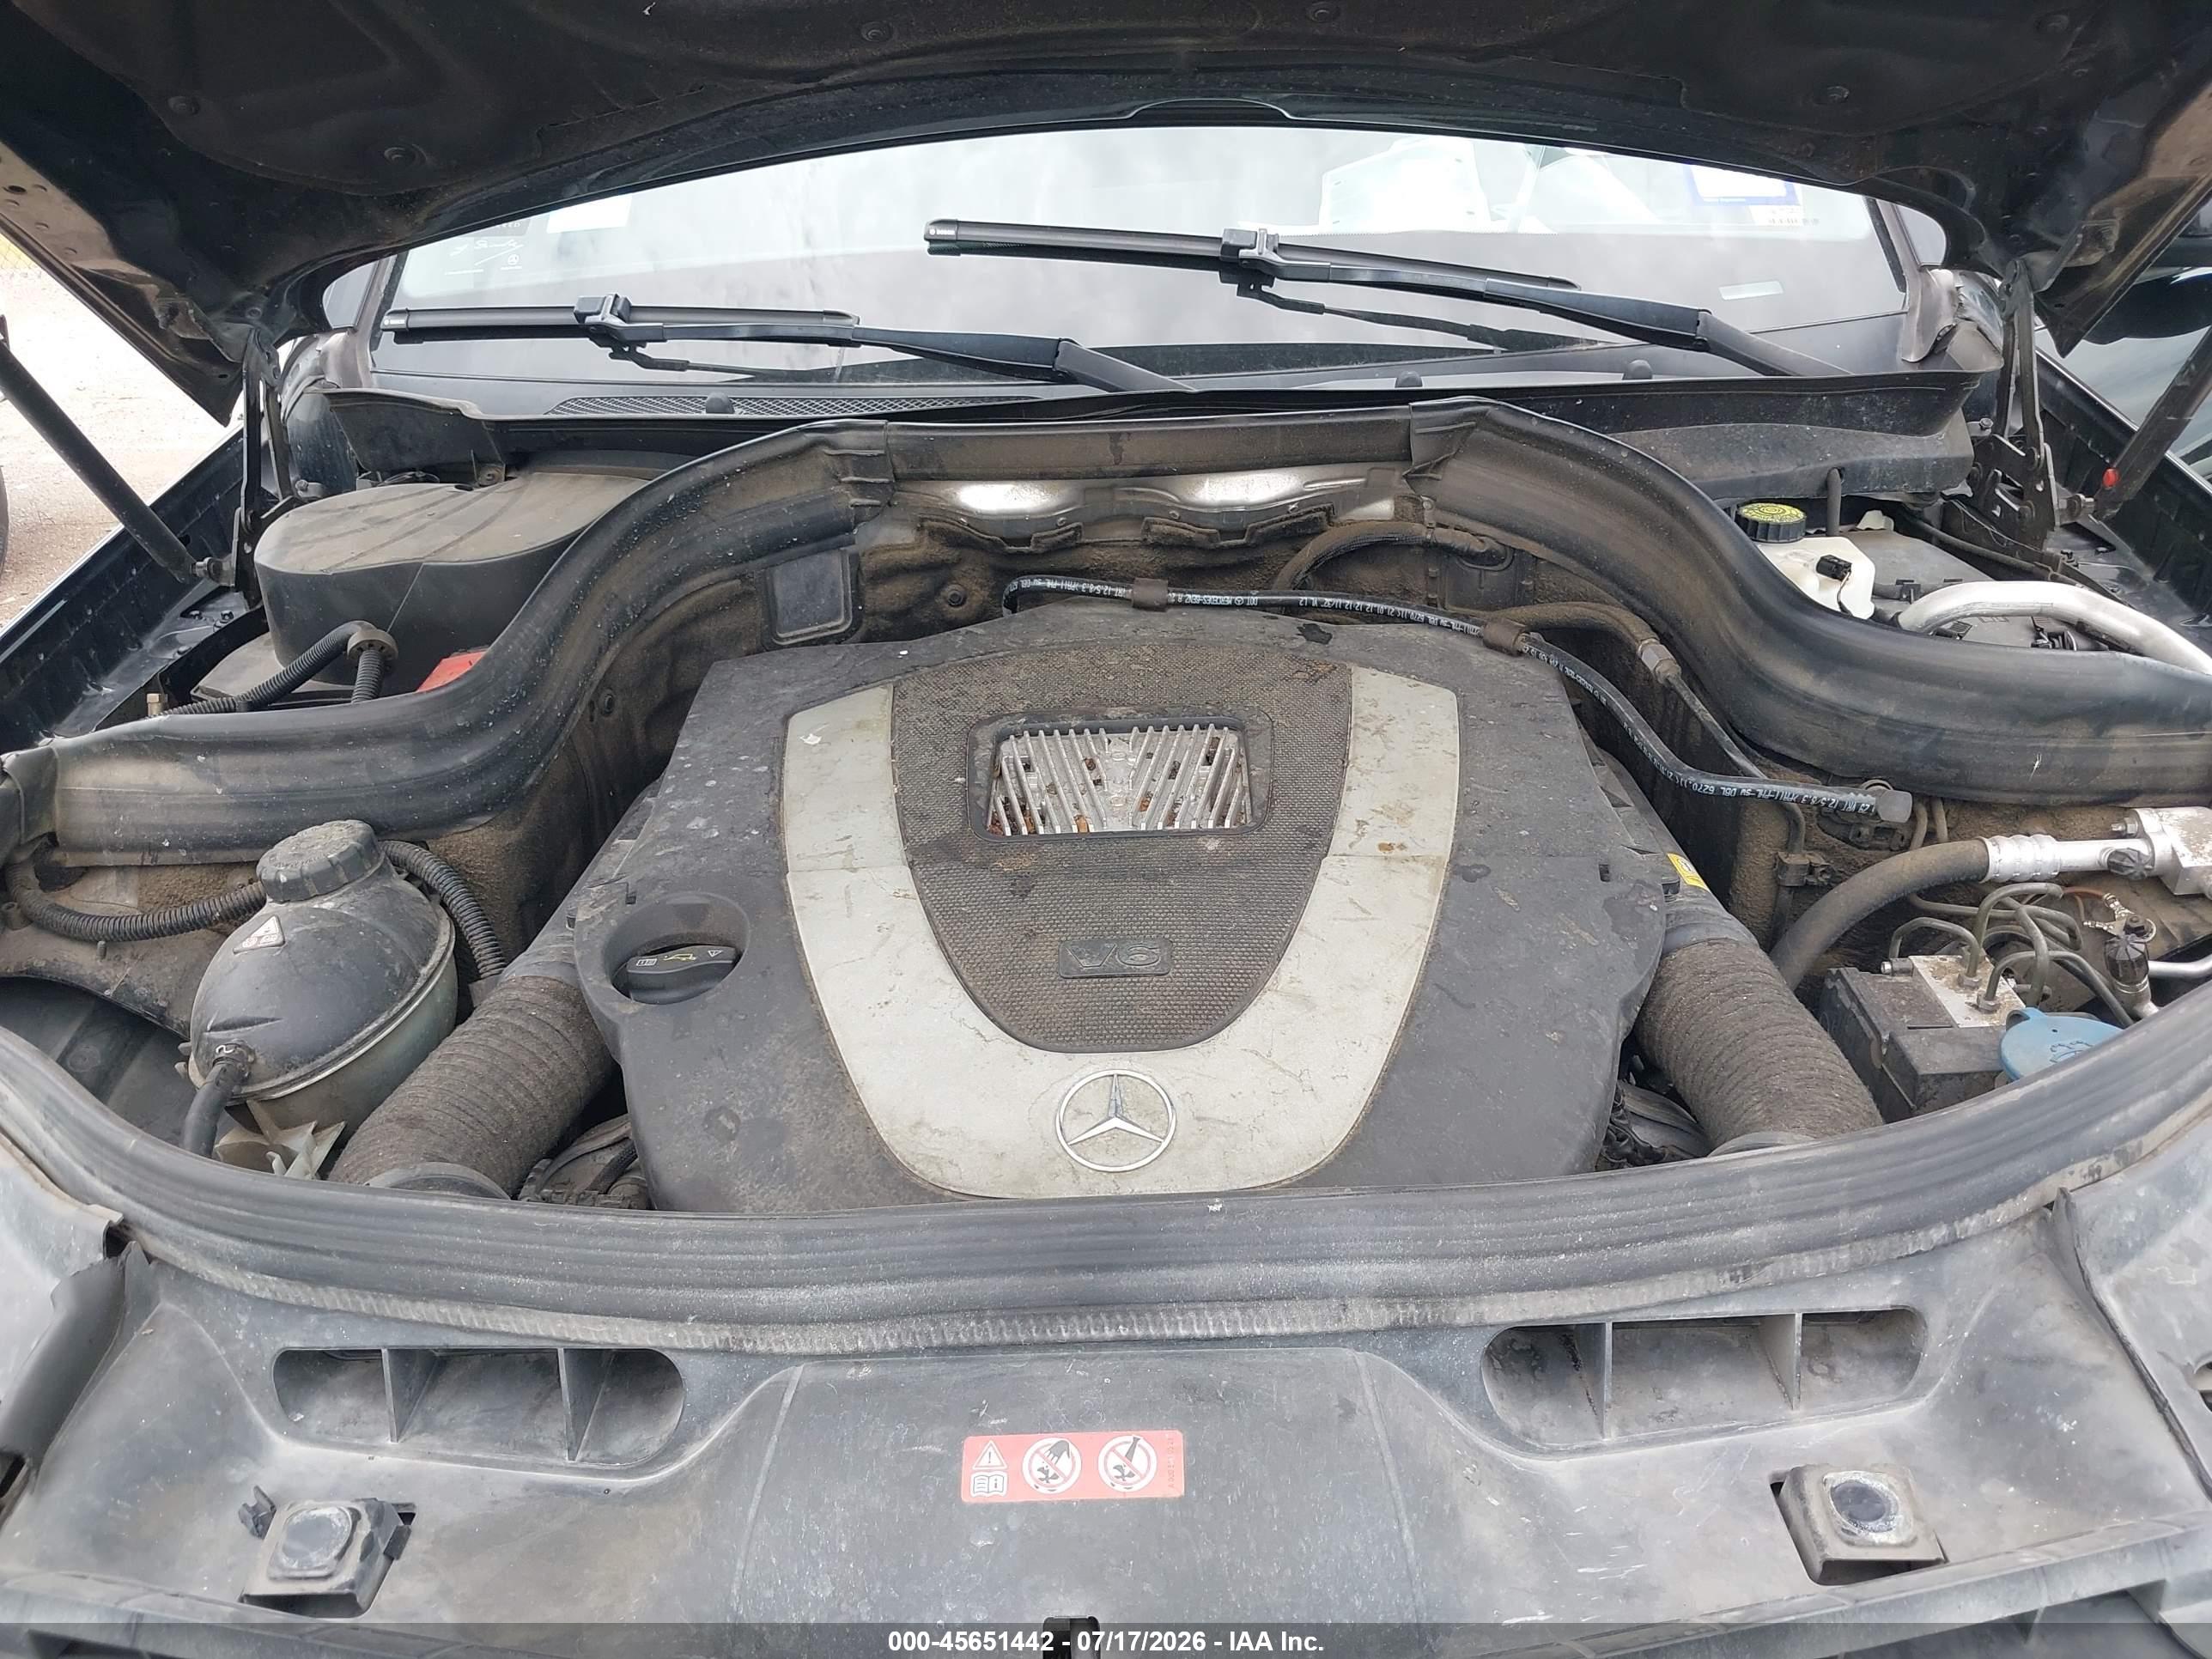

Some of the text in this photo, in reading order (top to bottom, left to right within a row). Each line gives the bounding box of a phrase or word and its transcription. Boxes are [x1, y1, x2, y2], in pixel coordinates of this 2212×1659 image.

[1721, 787, 1736, 797] DBL
[1802, 793, 1838, 809] 12.5/8.3
[1064, 941, 1162, 969] V6
